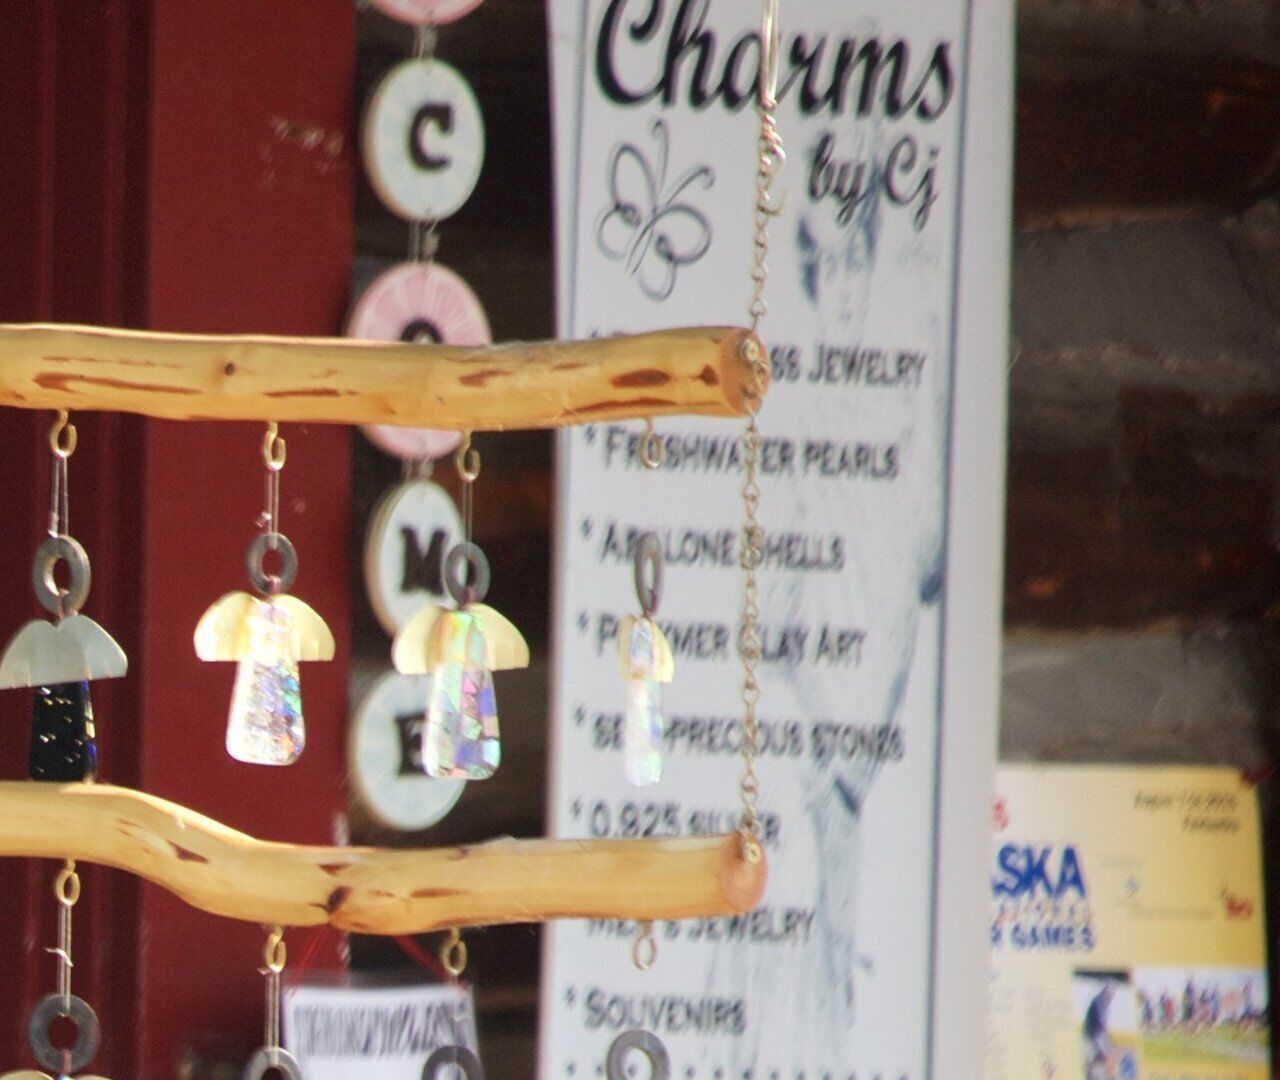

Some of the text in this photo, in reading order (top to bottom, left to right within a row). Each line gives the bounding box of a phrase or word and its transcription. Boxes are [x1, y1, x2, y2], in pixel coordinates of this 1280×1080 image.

[595, 0, 955, 122] Charms
[809, 131, 941, 231] by Cj
[807, 343, 927, 388] JEWELRY
[804, 440, 899, 481] PEARLS
[601, 521, 844, 571] ABLONE HELLS
[817, 622, 867, 667] ART
[811, 720, 906, 762] STONES
[584, 987, 747, 1036] SOUVENIRS
